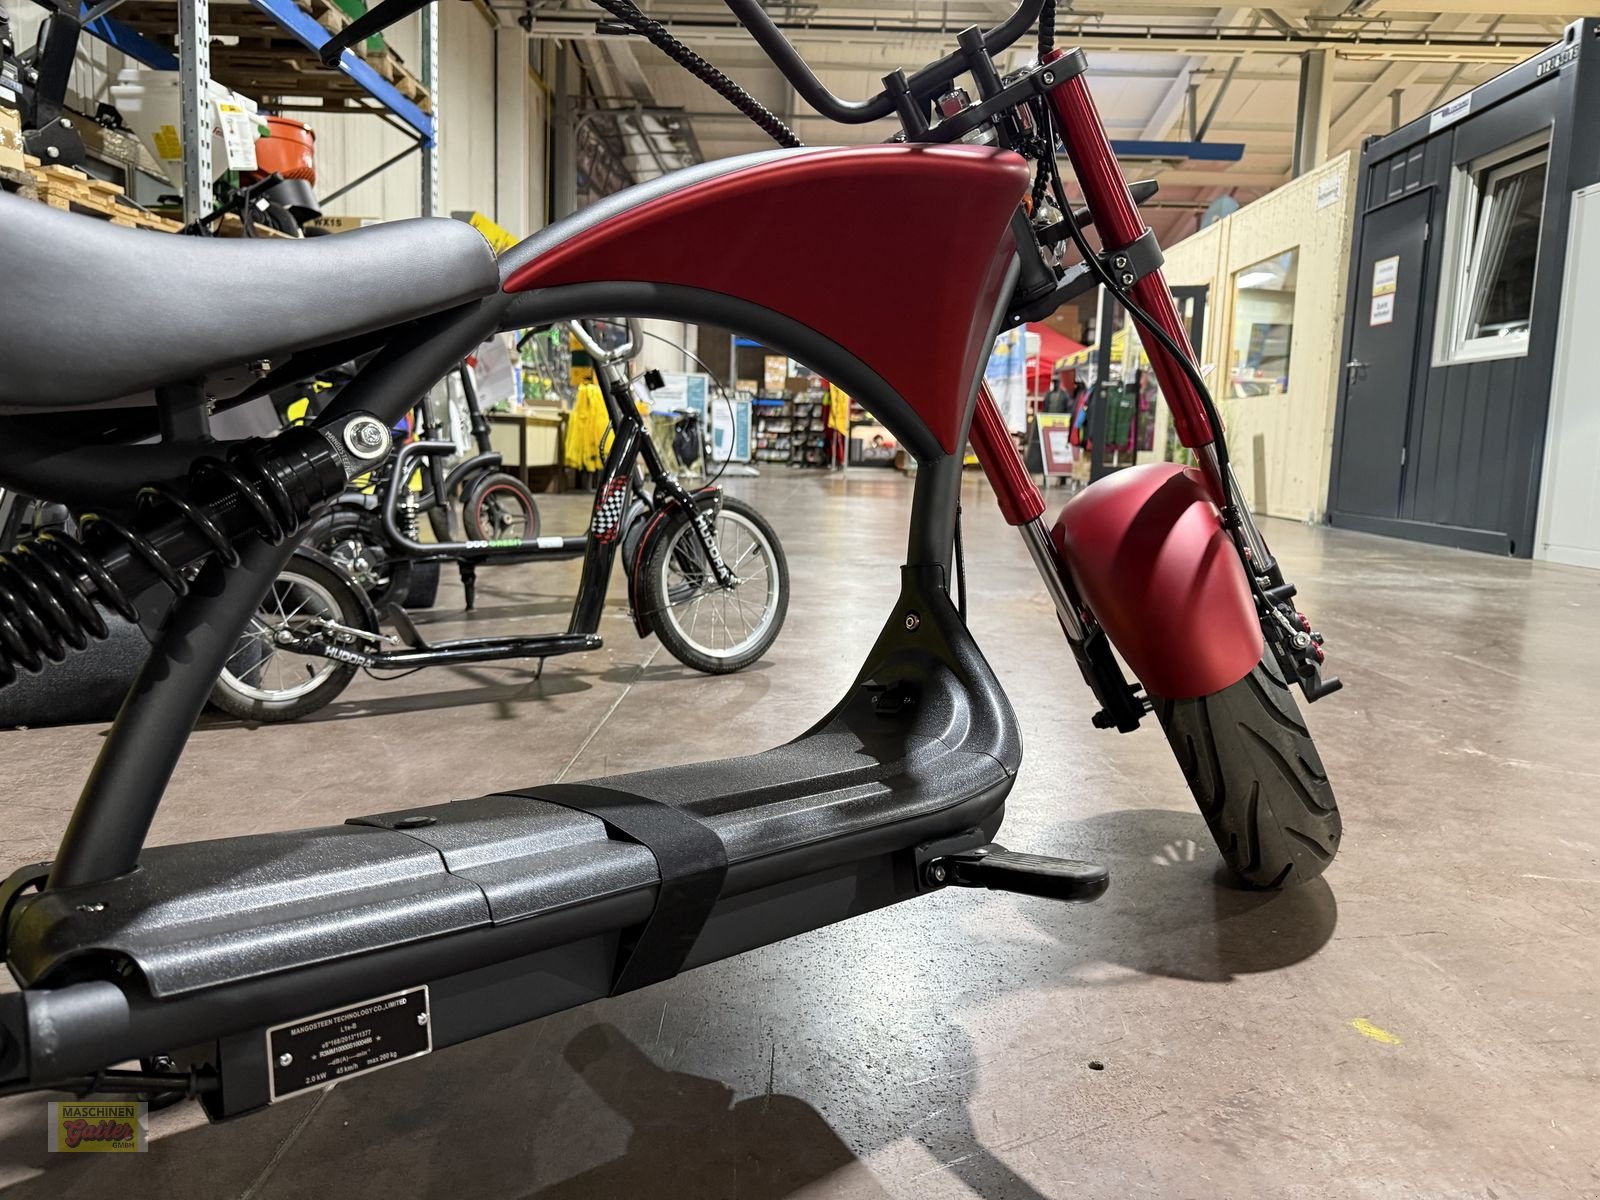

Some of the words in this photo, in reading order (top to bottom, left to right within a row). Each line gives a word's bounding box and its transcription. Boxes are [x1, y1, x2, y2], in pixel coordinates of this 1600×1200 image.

[325, 645, 372, 668] HUDORA
[291, 1019, 333, 1036] MANGOSTEEN
[334, 1008, 372, 1023] TECHNOLOGY
